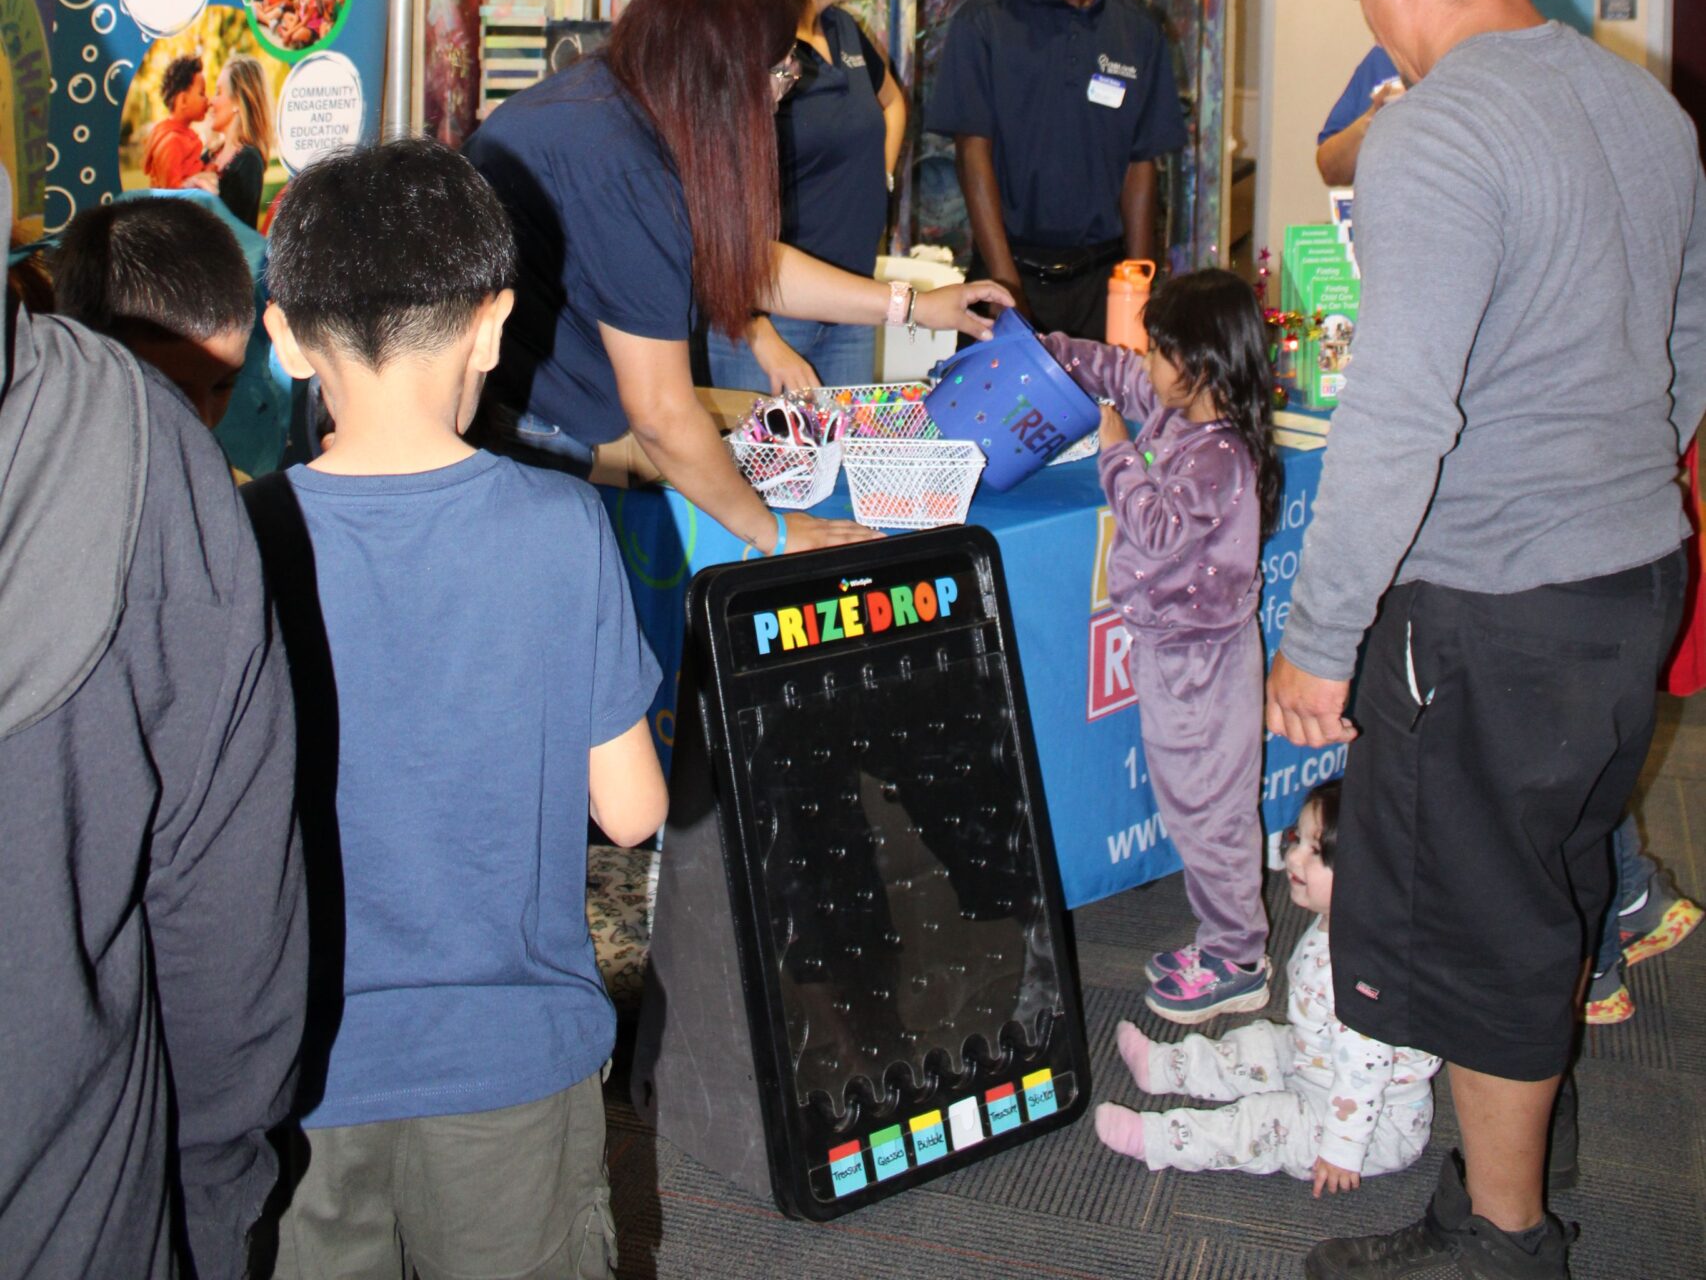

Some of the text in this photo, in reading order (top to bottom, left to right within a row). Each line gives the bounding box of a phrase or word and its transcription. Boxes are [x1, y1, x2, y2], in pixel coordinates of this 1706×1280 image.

[291, 86, 355, 99] COMMUNITY
[287, 98, 357, 112] ENGAGEMENT
[311, 112, 333, 123] AND
[290, 124, 349, 138] EDUCATION
[295, 137, 344, 151] SERVICES
[753, 576, 958, 655] PRIZE DROP
[917, 1132, 945, 1151] Bubble
